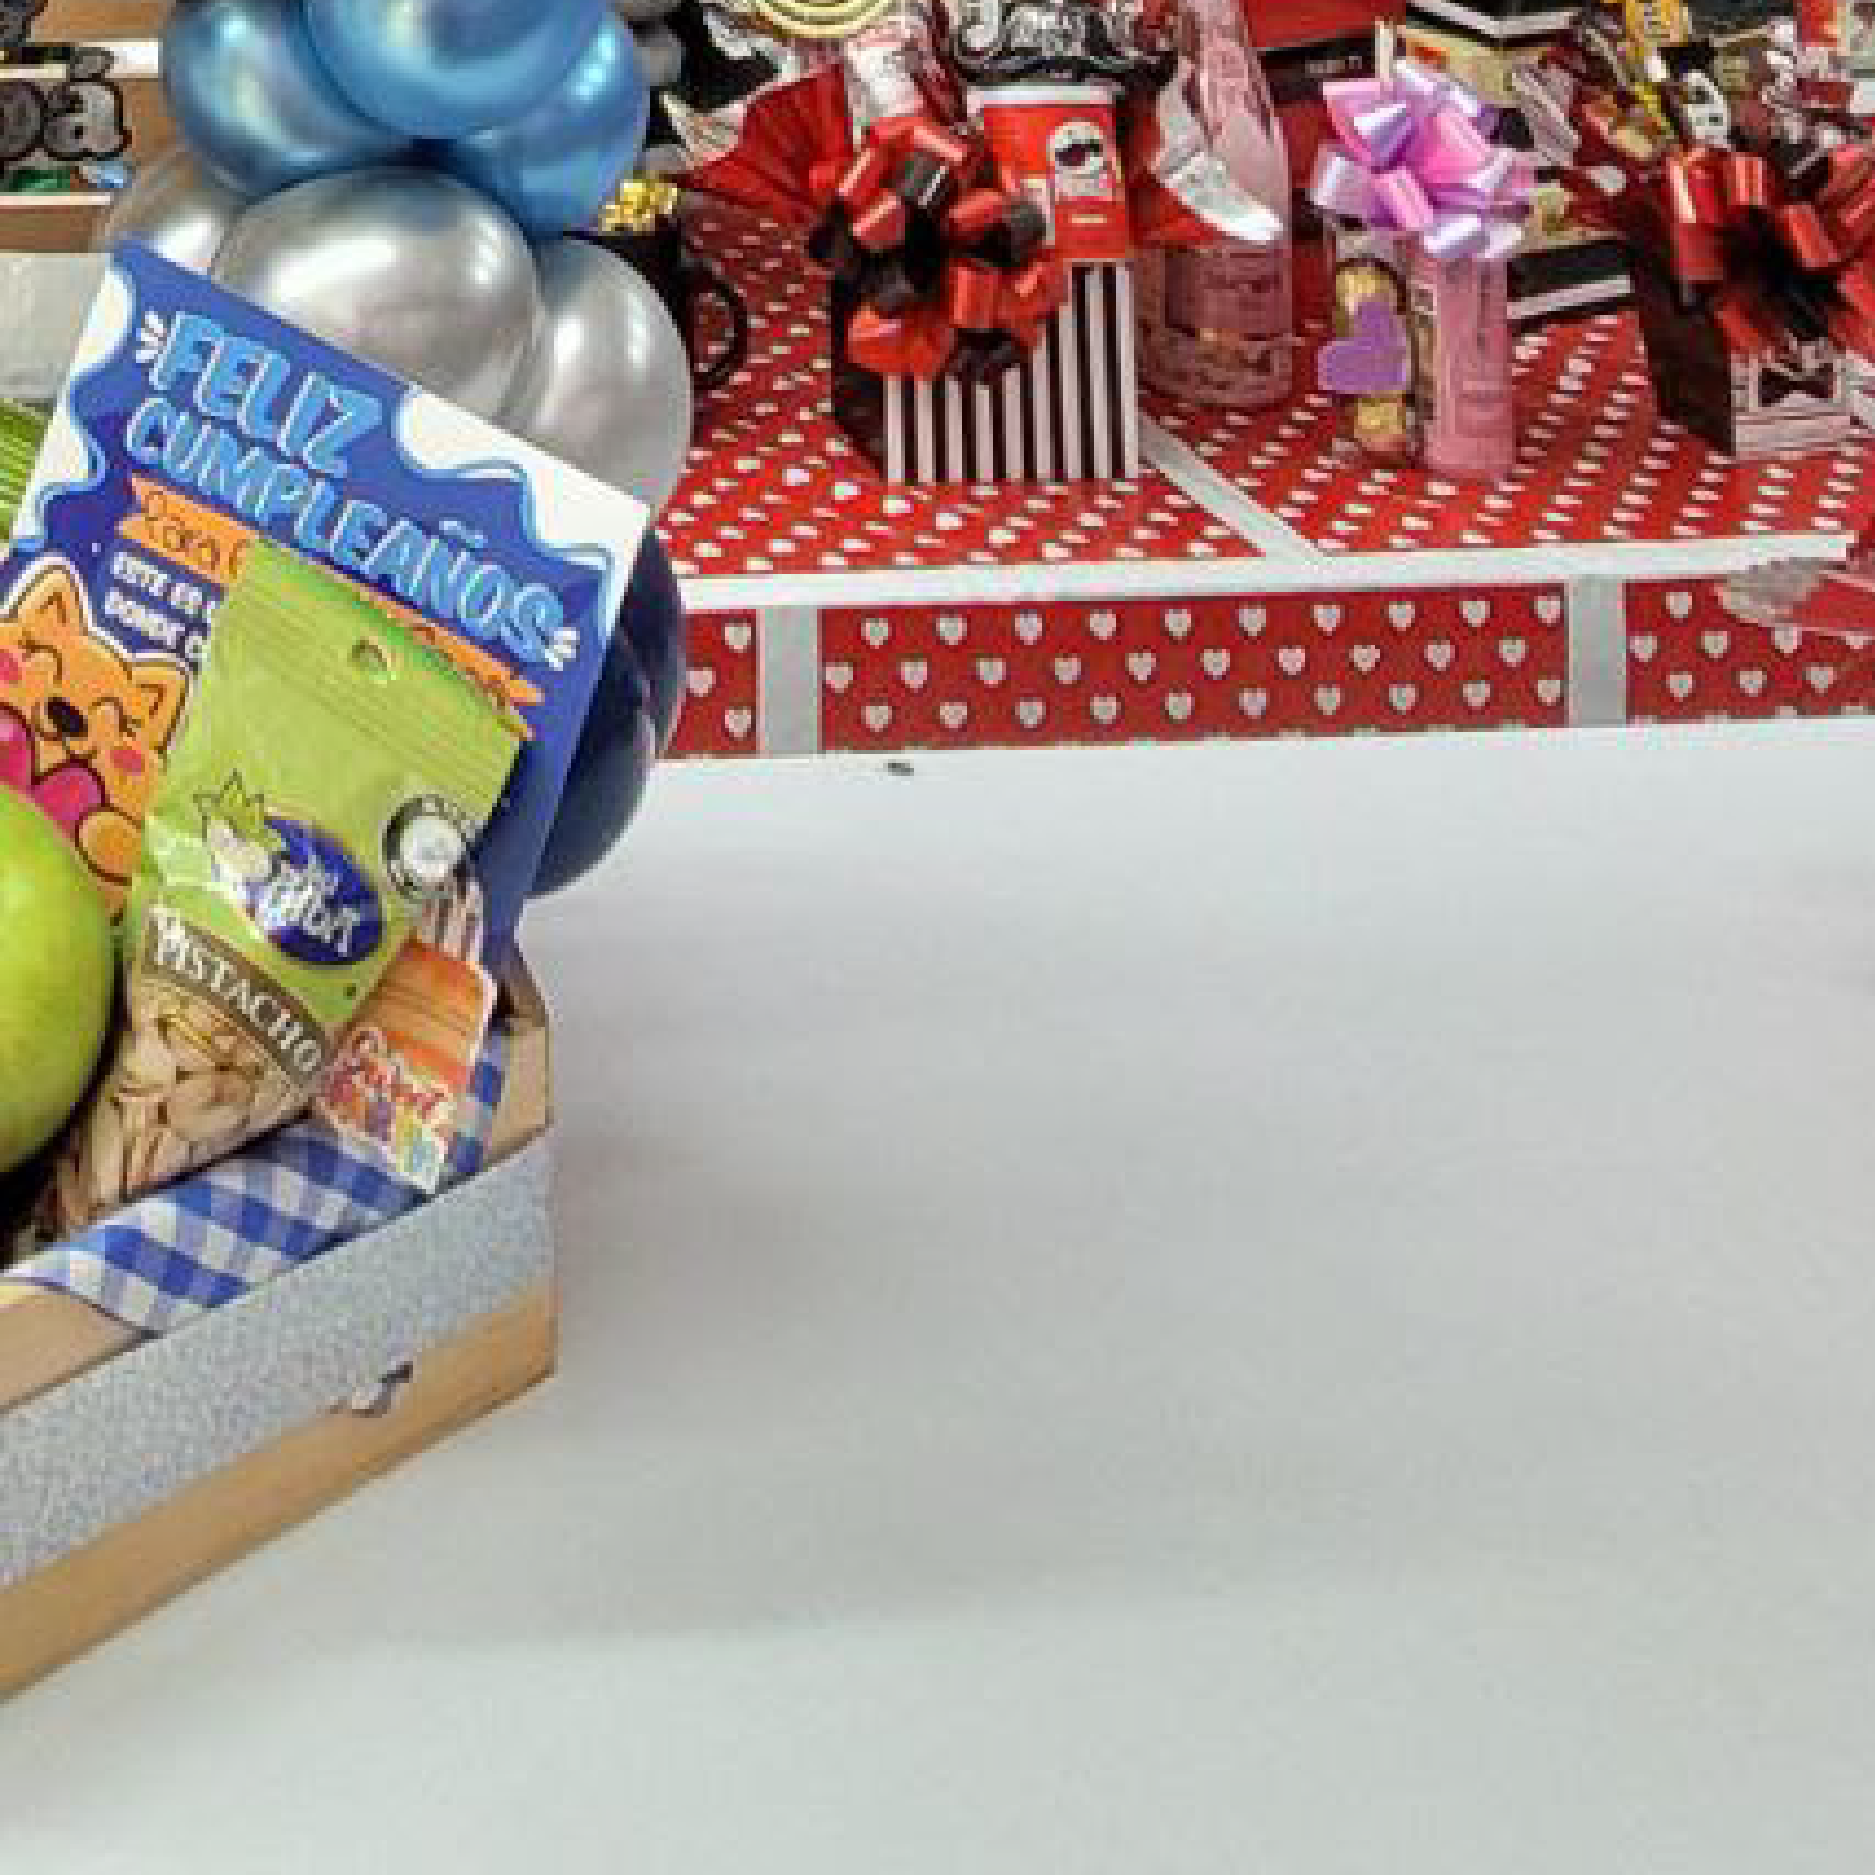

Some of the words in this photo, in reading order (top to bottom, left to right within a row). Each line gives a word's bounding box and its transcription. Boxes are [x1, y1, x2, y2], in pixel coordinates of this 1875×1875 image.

[153, 309, 382, 480] FELIZ
[127, 396, 567, 670] CUMPLEAÑOS
[148, 903, 323, 1079] PISTACHO
